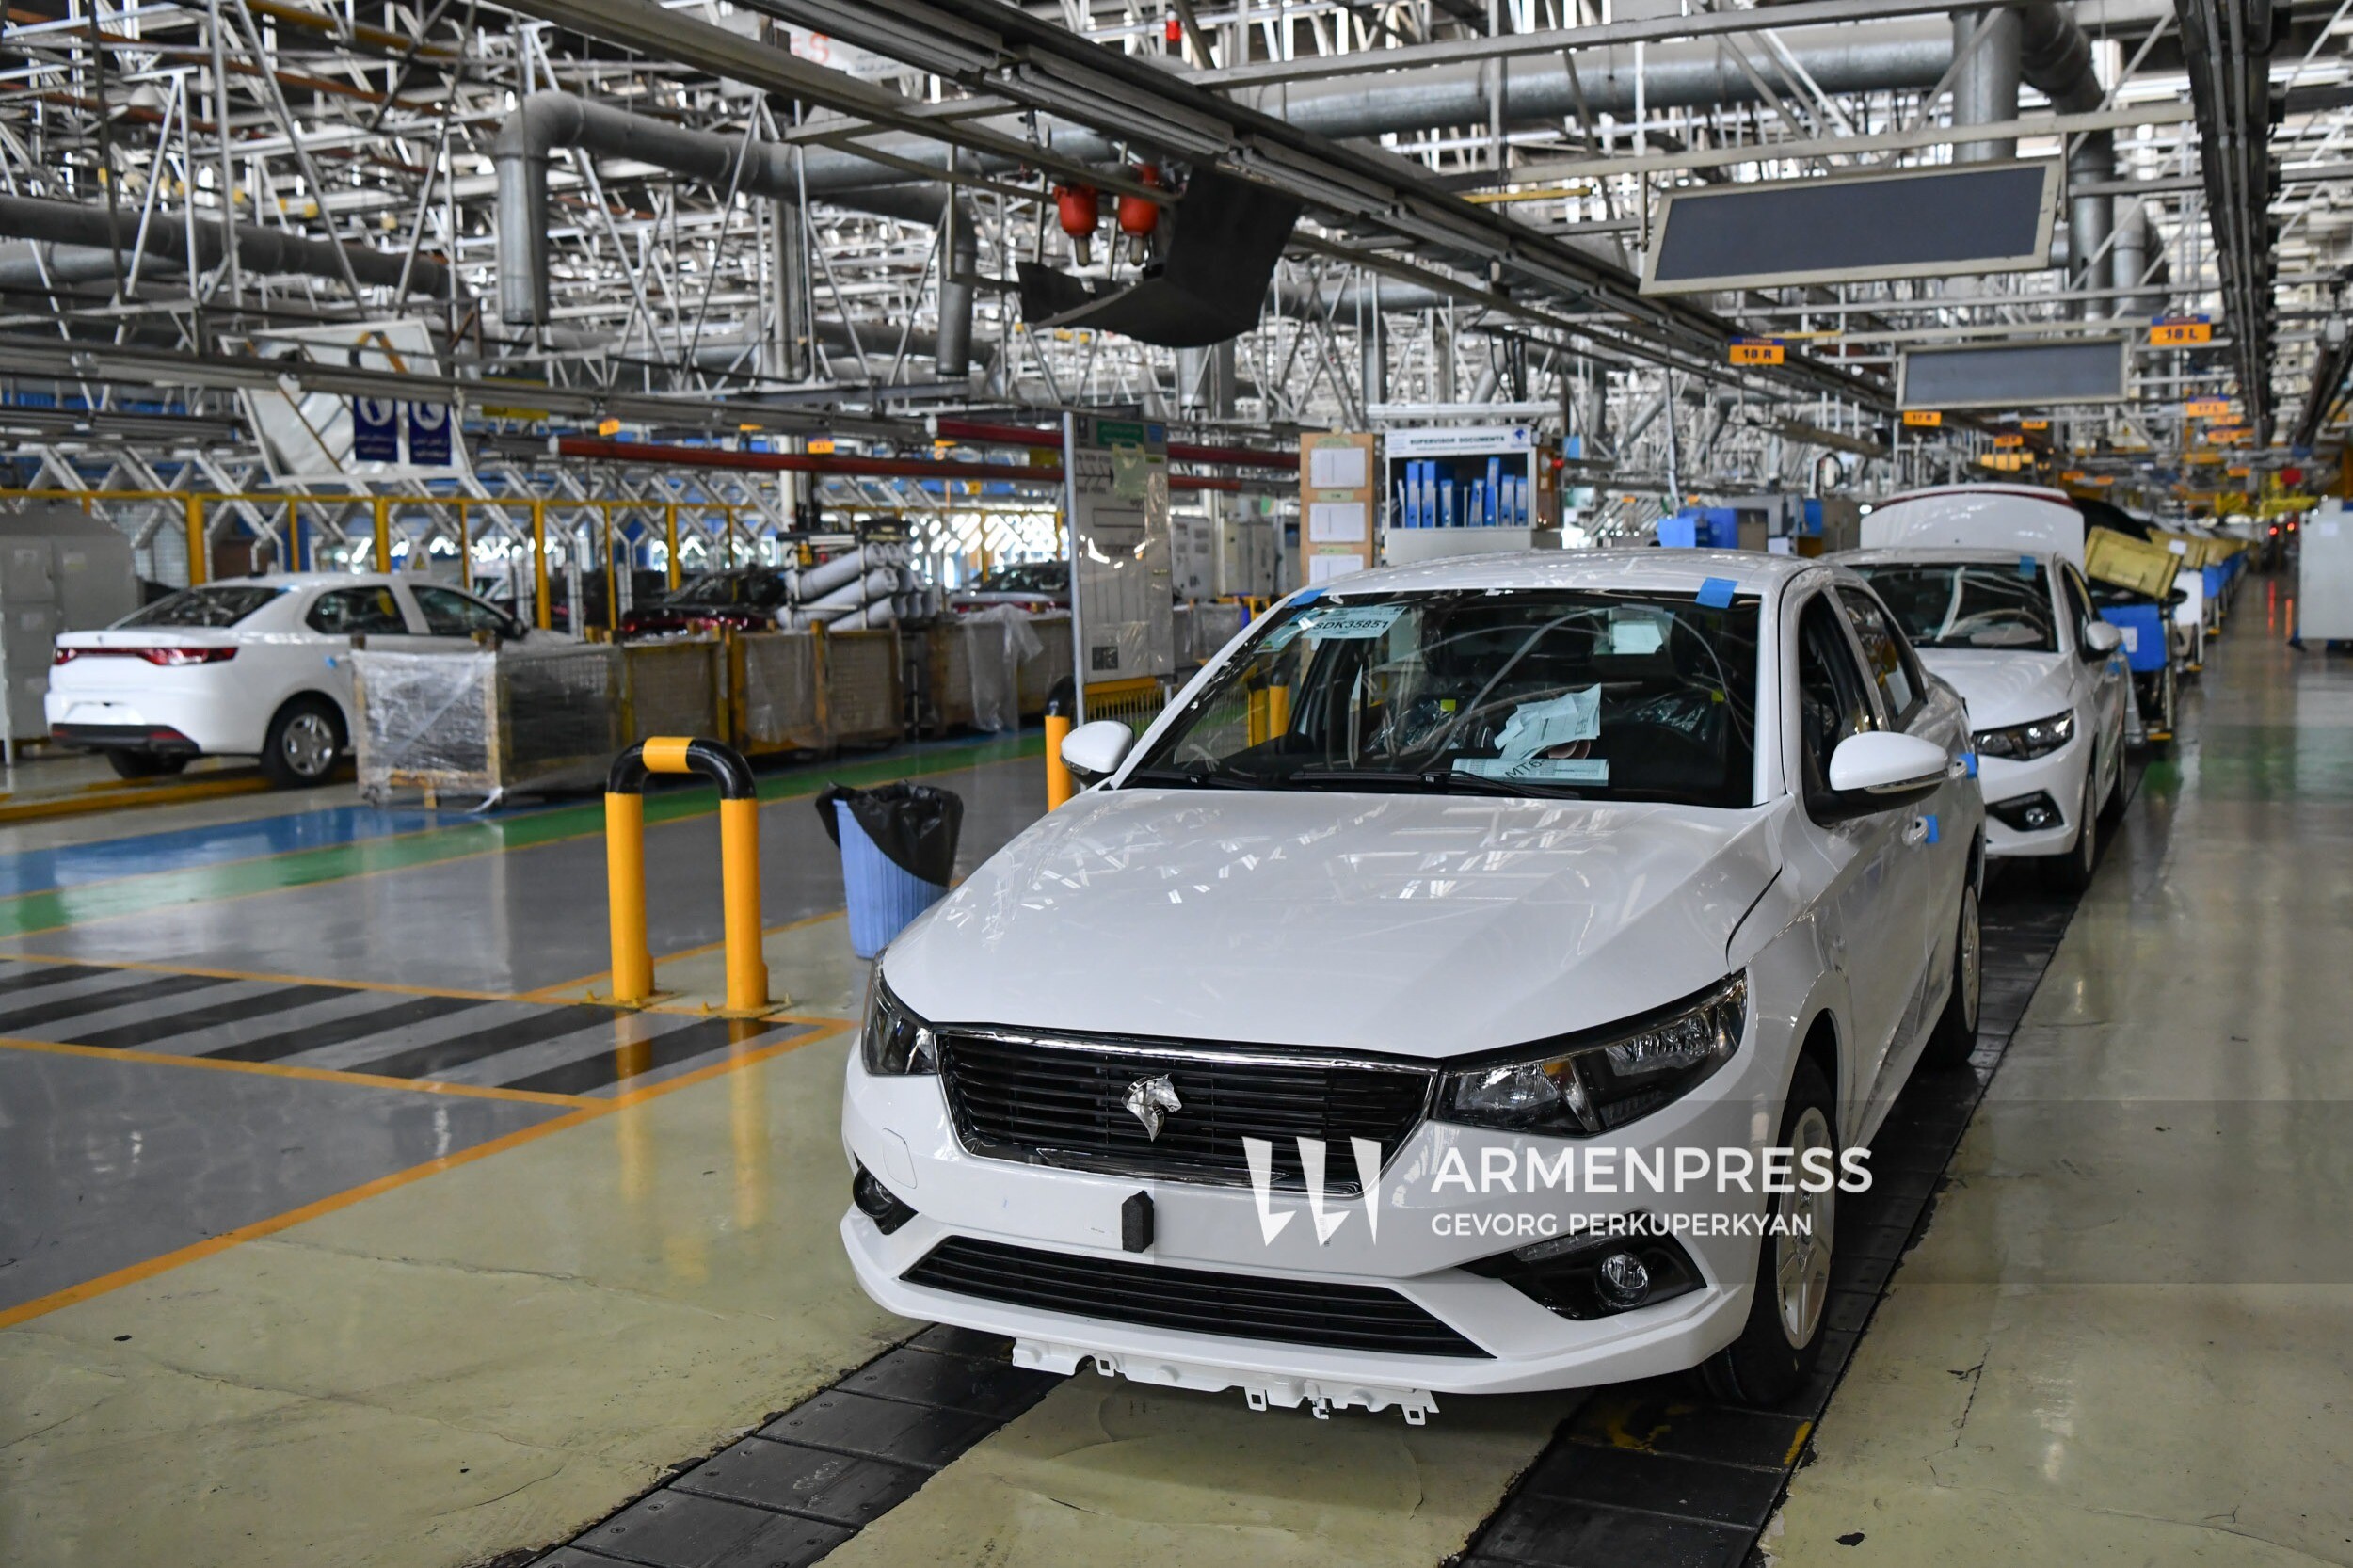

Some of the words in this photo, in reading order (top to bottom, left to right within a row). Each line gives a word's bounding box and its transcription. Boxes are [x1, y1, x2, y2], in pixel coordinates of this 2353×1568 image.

[2189, 328, 2199, 340] L
[1743, 348, 1758, 359] 18
[1764, 348, 1772, 359] R
[1410, 437, 1455, 445] SUPERVISOR
[1459, 435, 1505, 444] DOCUMENTS
